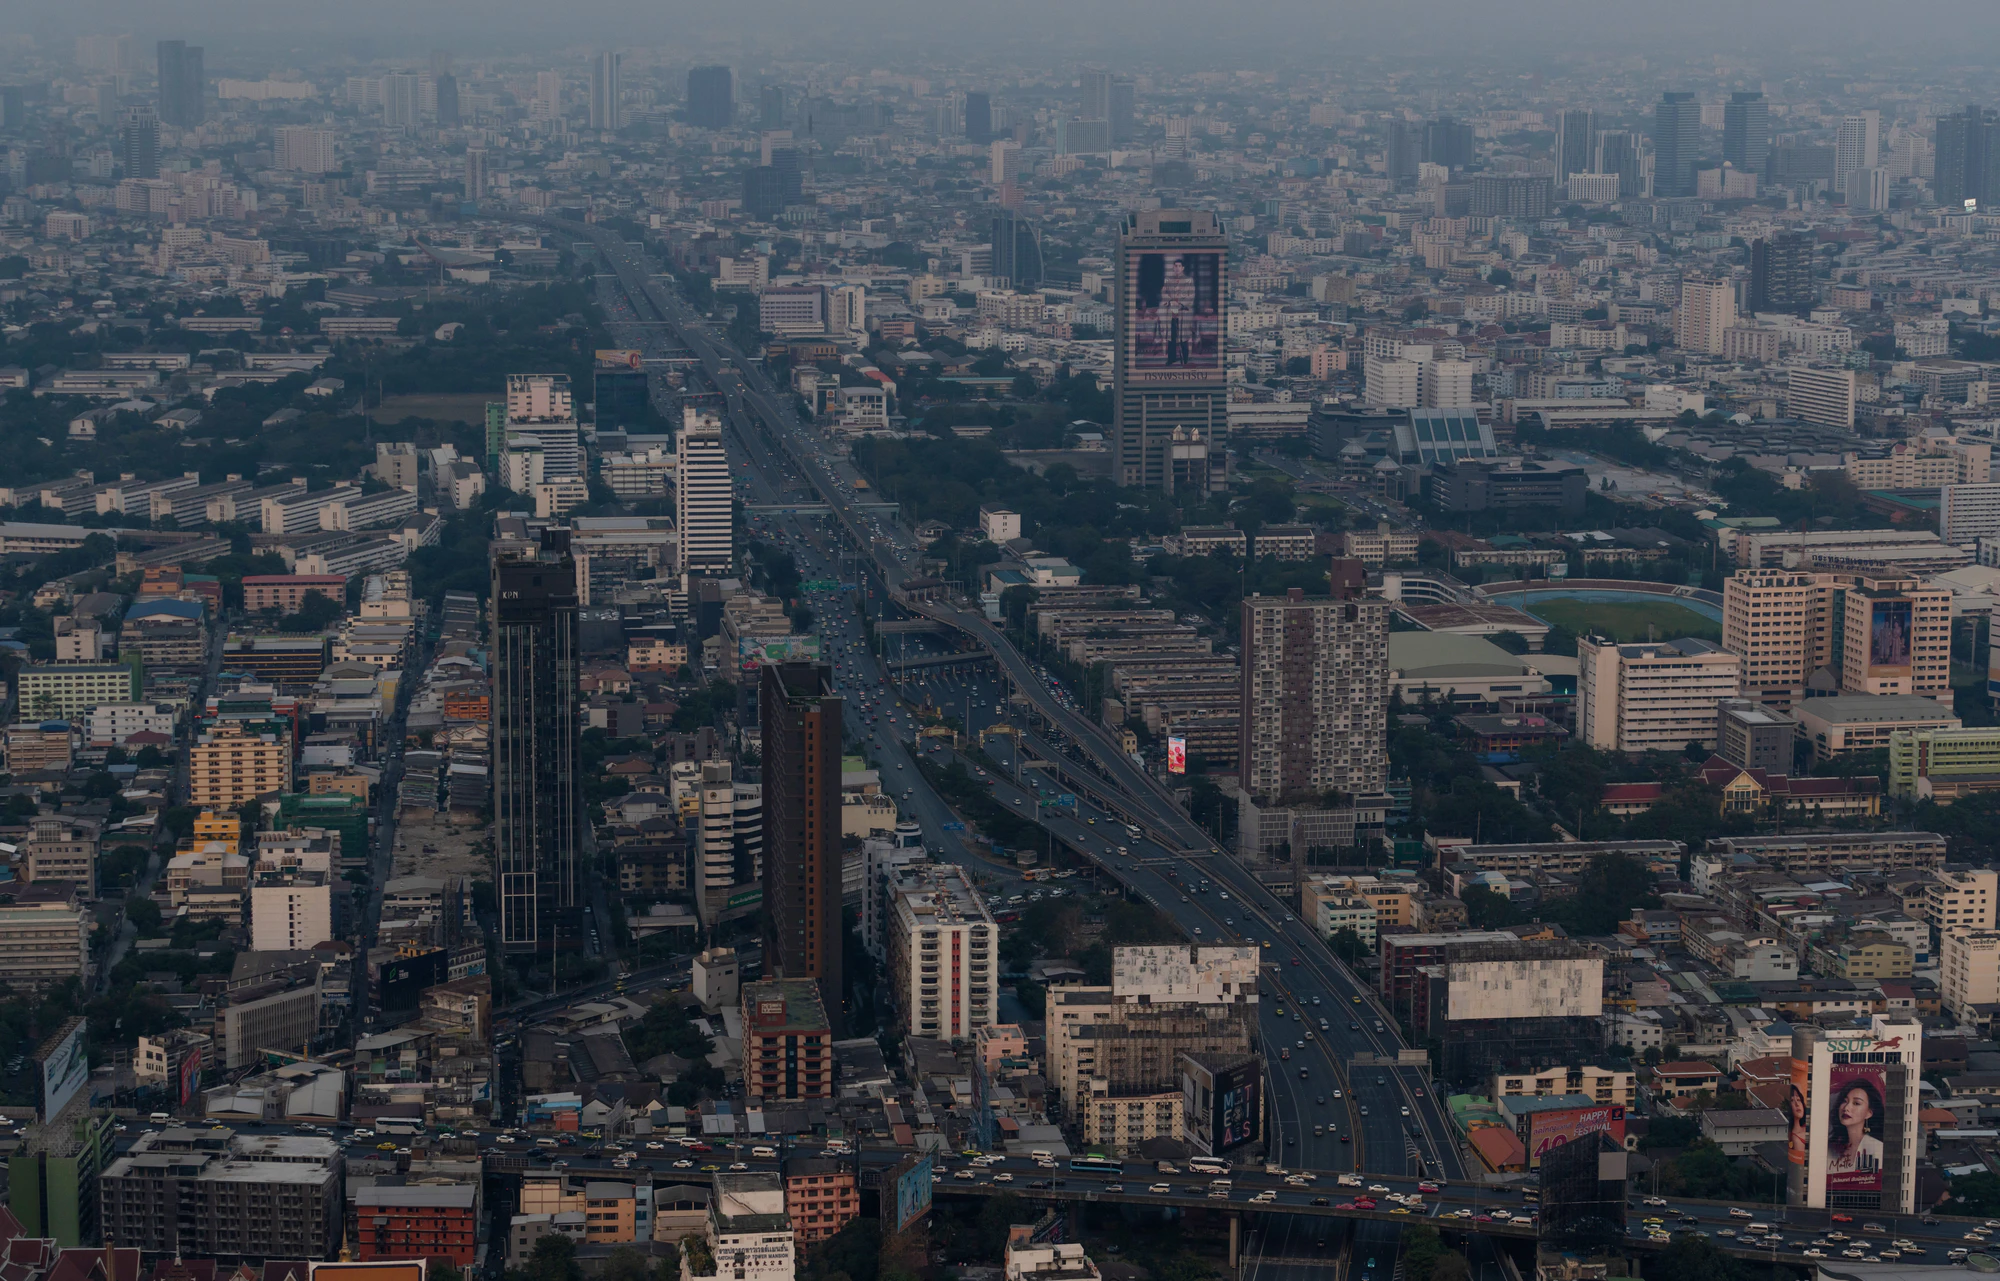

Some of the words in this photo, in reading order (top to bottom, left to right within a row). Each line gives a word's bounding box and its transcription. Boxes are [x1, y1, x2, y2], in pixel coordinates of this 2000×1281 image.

[1144, 369, 1208, 381] ทรงพระเจริญ
[1813, 562, 1844, 570] MINISTRY
[1856, 566, 1884, 574] LABOUR
[502, 590, 519, 599] KPN
[1826, 1039, 1872, 1052] SSUP
[1857, 1066, 1885, 1075] press
[1579, 1109, 1609, 1122] HAPPY
[1573, 1121, 1612, 1137] FESTIVAL
